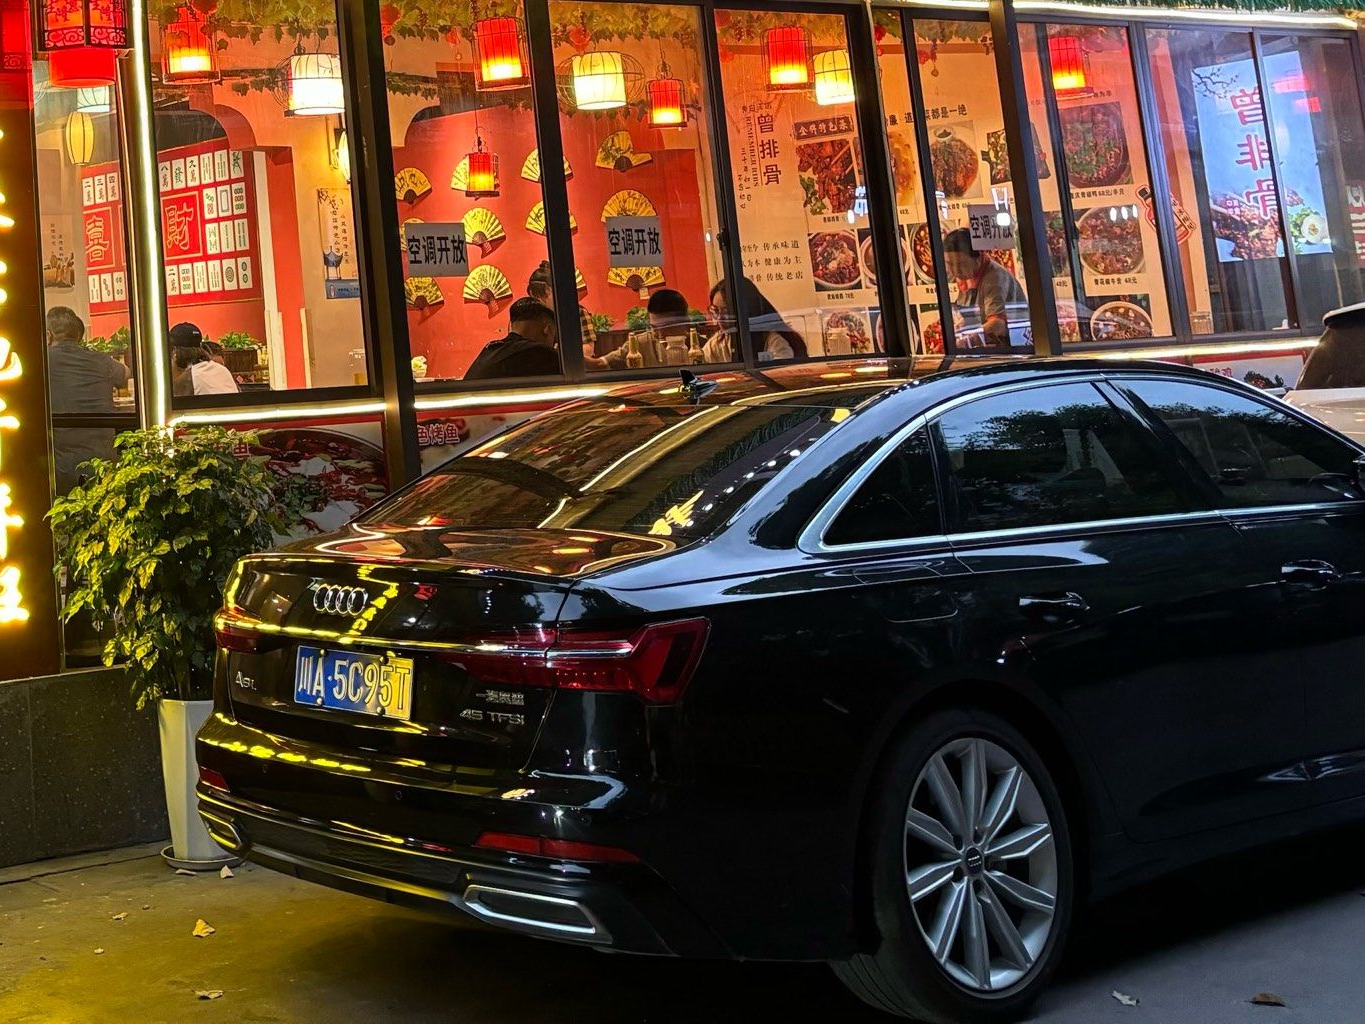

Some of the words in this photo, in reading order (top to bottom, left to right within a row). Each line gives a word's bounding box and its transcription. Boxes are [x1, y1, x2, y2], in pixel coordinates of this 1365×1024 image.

[757, 113, 782, 186] 曾排骨
[407, 234, 466, 266] 空调开放
[608, 225, 662, 255] 空调开放
